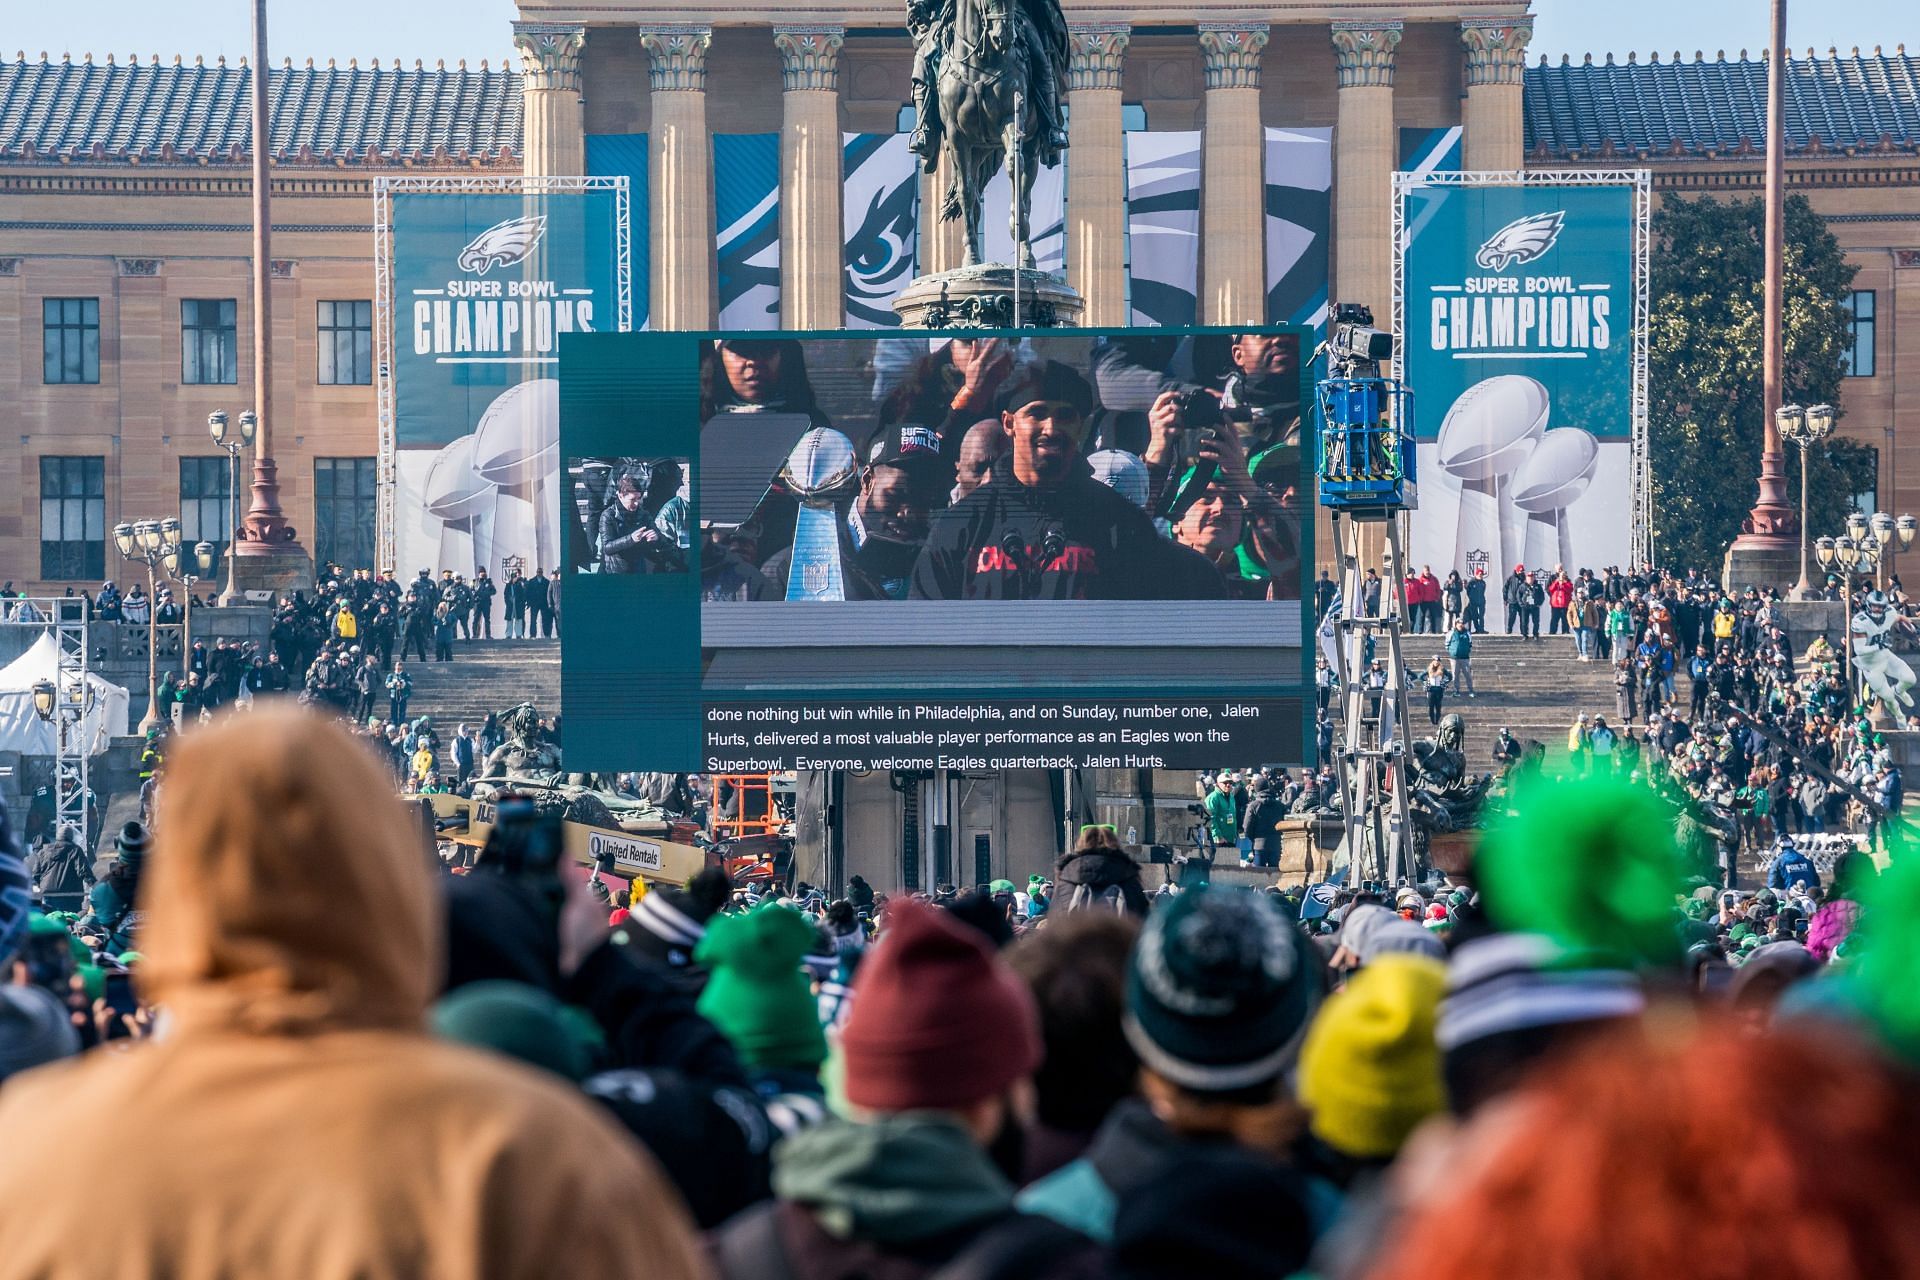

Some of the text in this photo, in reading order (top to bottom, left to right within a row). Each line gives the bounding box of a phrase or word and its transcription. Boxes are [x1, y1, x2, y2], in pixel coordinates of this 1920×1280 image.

[447, 280, 559, 297] SUPER BOWL
[1465, 276, 1576, 293] SUPER BOWL
[1431, 296, 1610, 350] CHAMPIONS
[708, 703, 1260, 724] done nothing but win while in Philadelphia, and on Sunday, number one, Jalen
[708, 729, 1230, 748] Hurts, delivered a most valuable player performance as an Eagles won the
[708, 753, 1167, 772] Superbowl. Everyone, welcome Eagles quarterback, Jalen Hurts.
[602, 839, 658, 865] United Rentals
